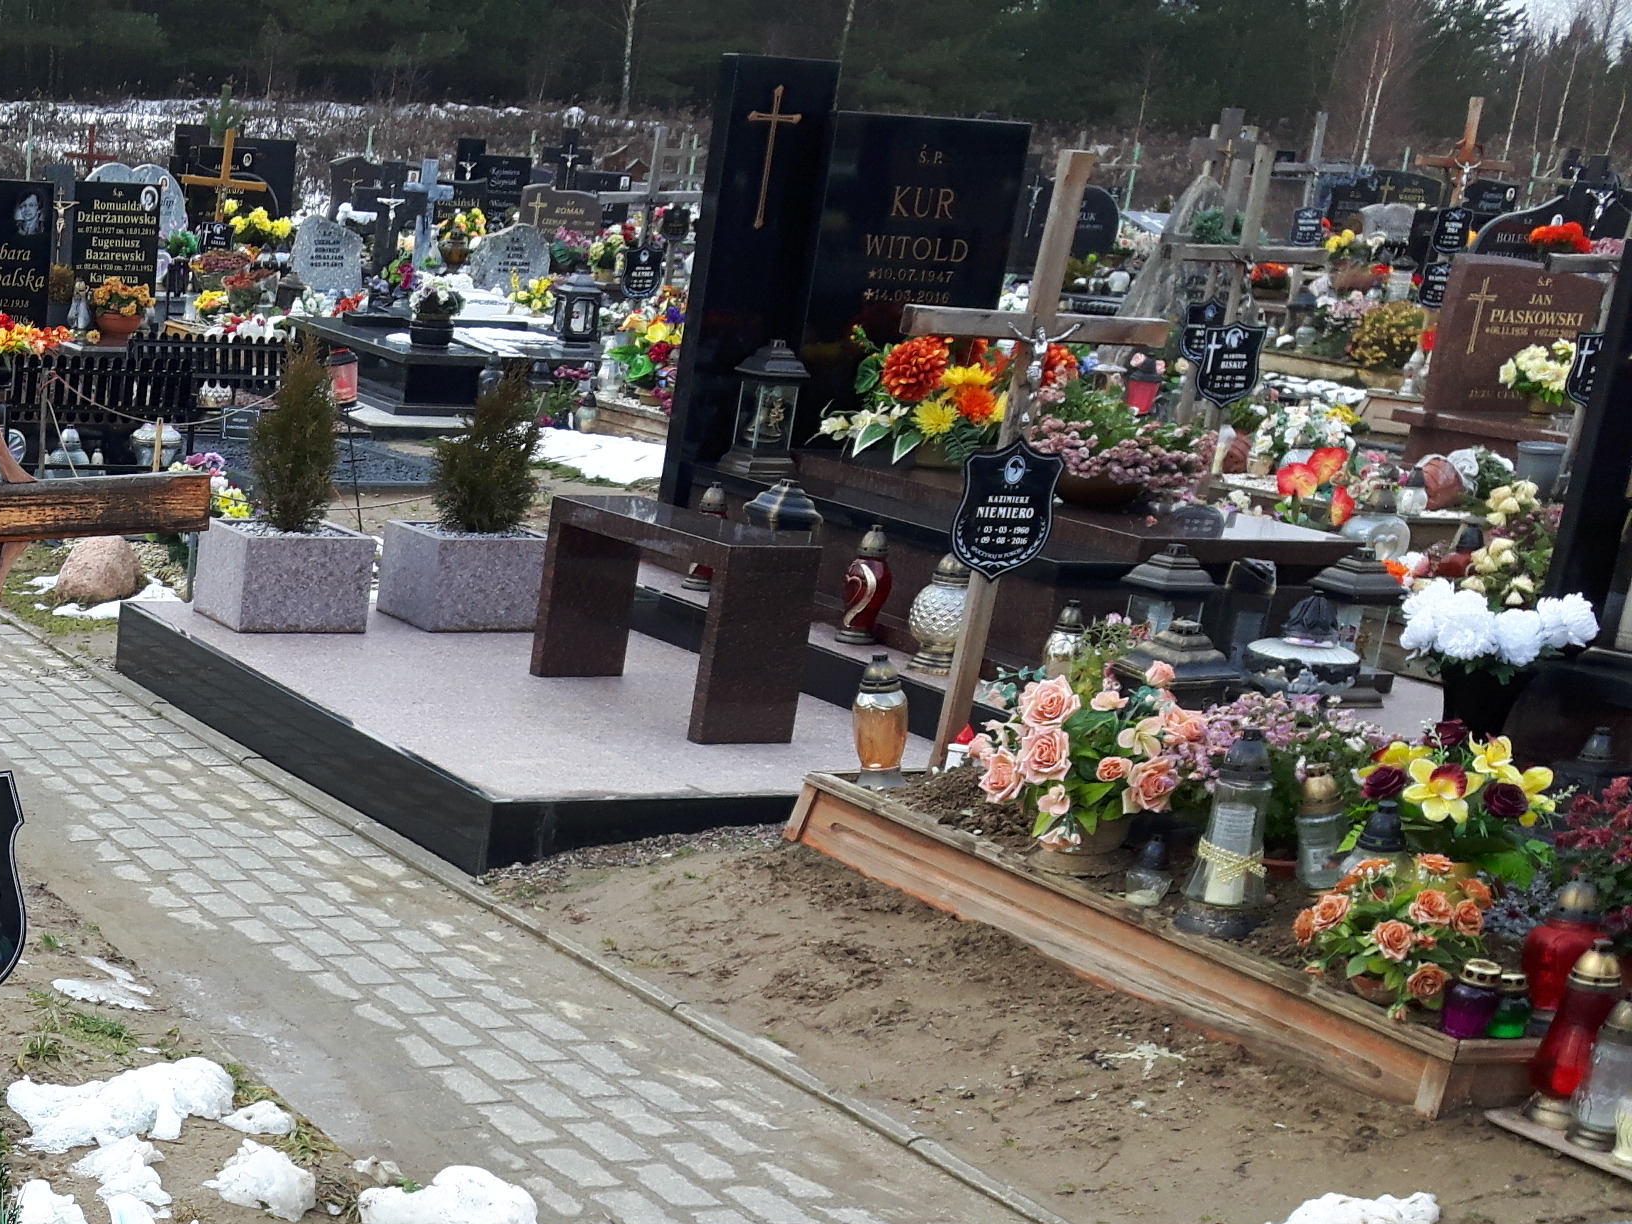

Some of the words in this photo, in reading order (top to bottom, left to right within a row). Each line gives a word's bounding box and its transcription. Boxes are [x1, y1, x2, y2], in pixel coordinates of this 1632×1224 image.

[93, 199, 143, 212] Romualda
[890, 185, 955, 220] KUR
[554, 206, 585, 215] ROMAN
[77, 211, 157, 225] Dzierżanowska
[91, 236, 141, 250] Eugeniusz
[866, 233, 970, 263] WITOLD
[85, 248, 146, 262] Bazarewski
[89, 272, 139, 285] Katyna
[1528, 293, 1553, 306] JAN
[1489, 308, 1584, 327] PIASKOWSKI
[987, 495, 1031, 504] KAZIMIERZ
[975, 506, 1035, 520] NIEMIERO
